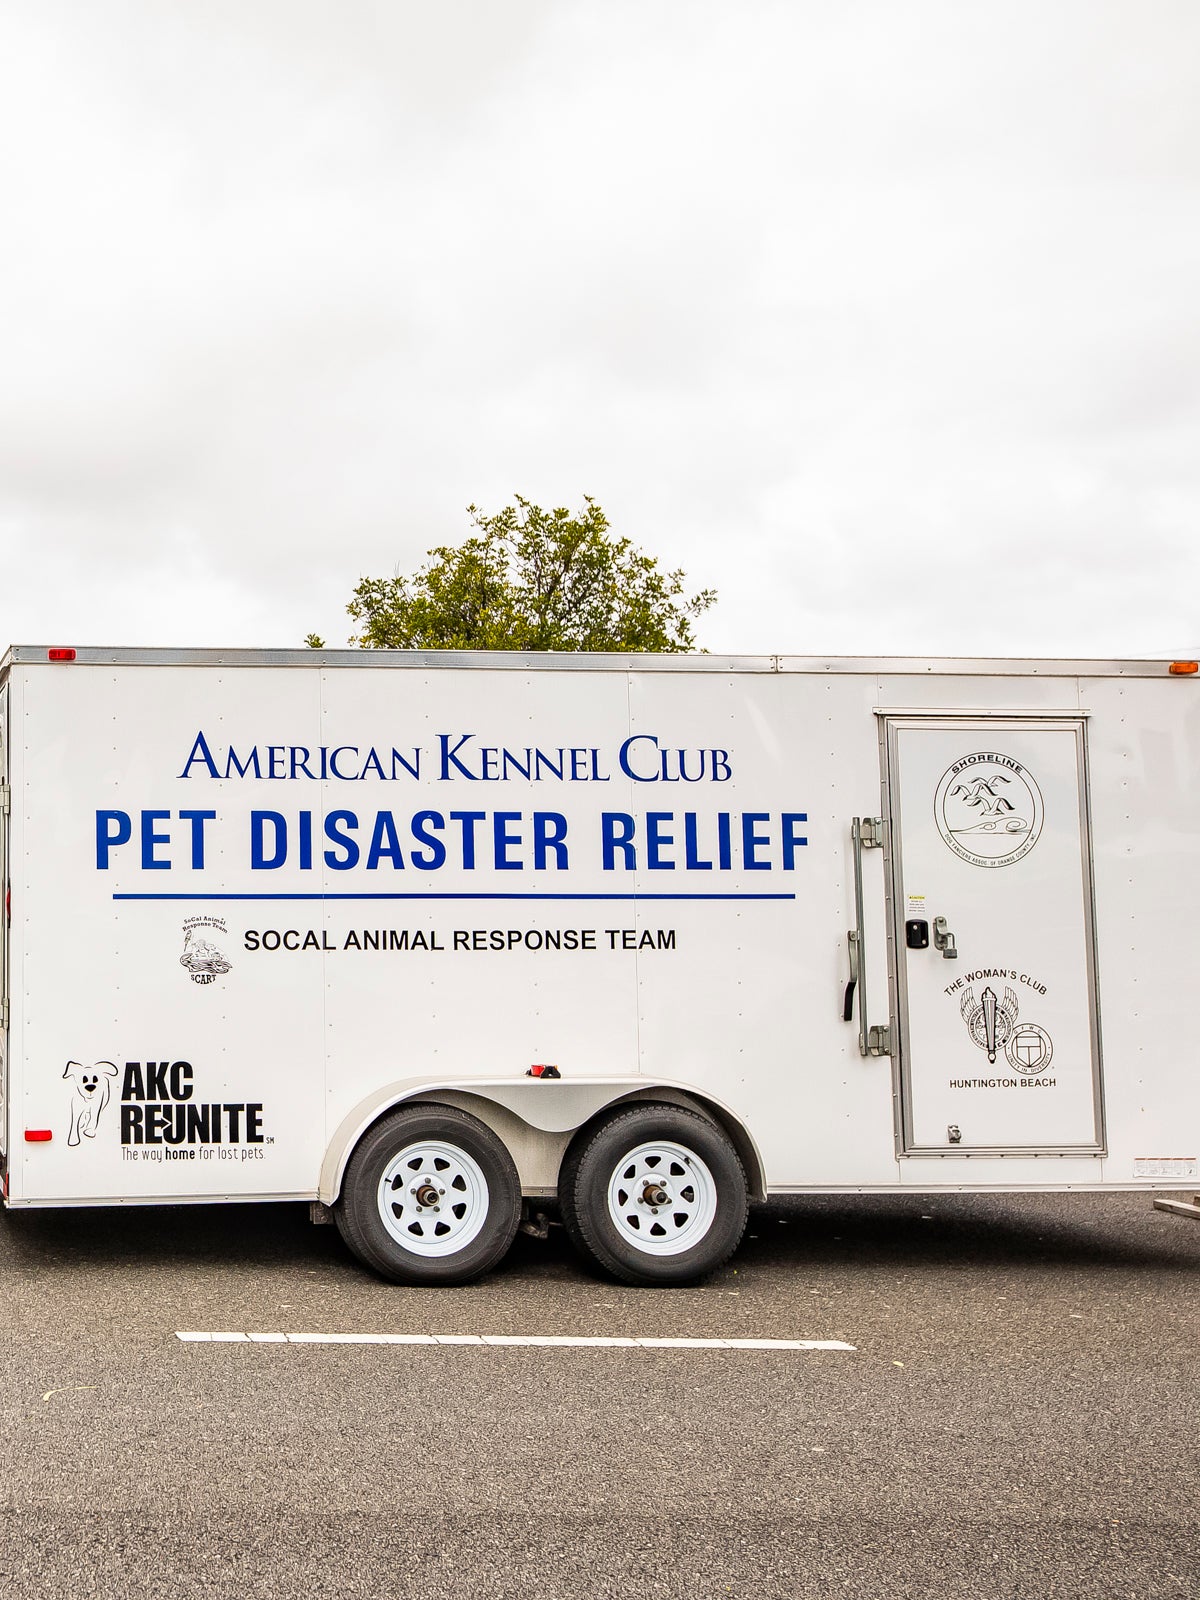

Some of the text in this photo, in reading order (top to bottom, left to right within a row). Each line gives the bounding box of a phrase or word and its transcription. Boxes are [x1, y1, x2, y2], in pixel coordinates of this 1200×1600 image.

[177, 731, 732, 782] AMERICAN KENNEL CLUB
[951, 755, 1023, 774] SHORELINE
[96, 810, 808, 871] PET DISASTER RELIEF
[245, 929, 676, 951] SOCAL ANIMAL RESPONSE TEAM
[191, 974, 217, 985] SCART
[944, 969, 1048, 997] THE WOMAN'S CLUB
[121, 1061, 194, 1101] AKC
[949, 1078, 1057, 1088] HUNTINGTON BEACH
[120, 1103, 265, 1145] REUNITE
[121, 1146, 266, 1163] The way home for lost pets.
